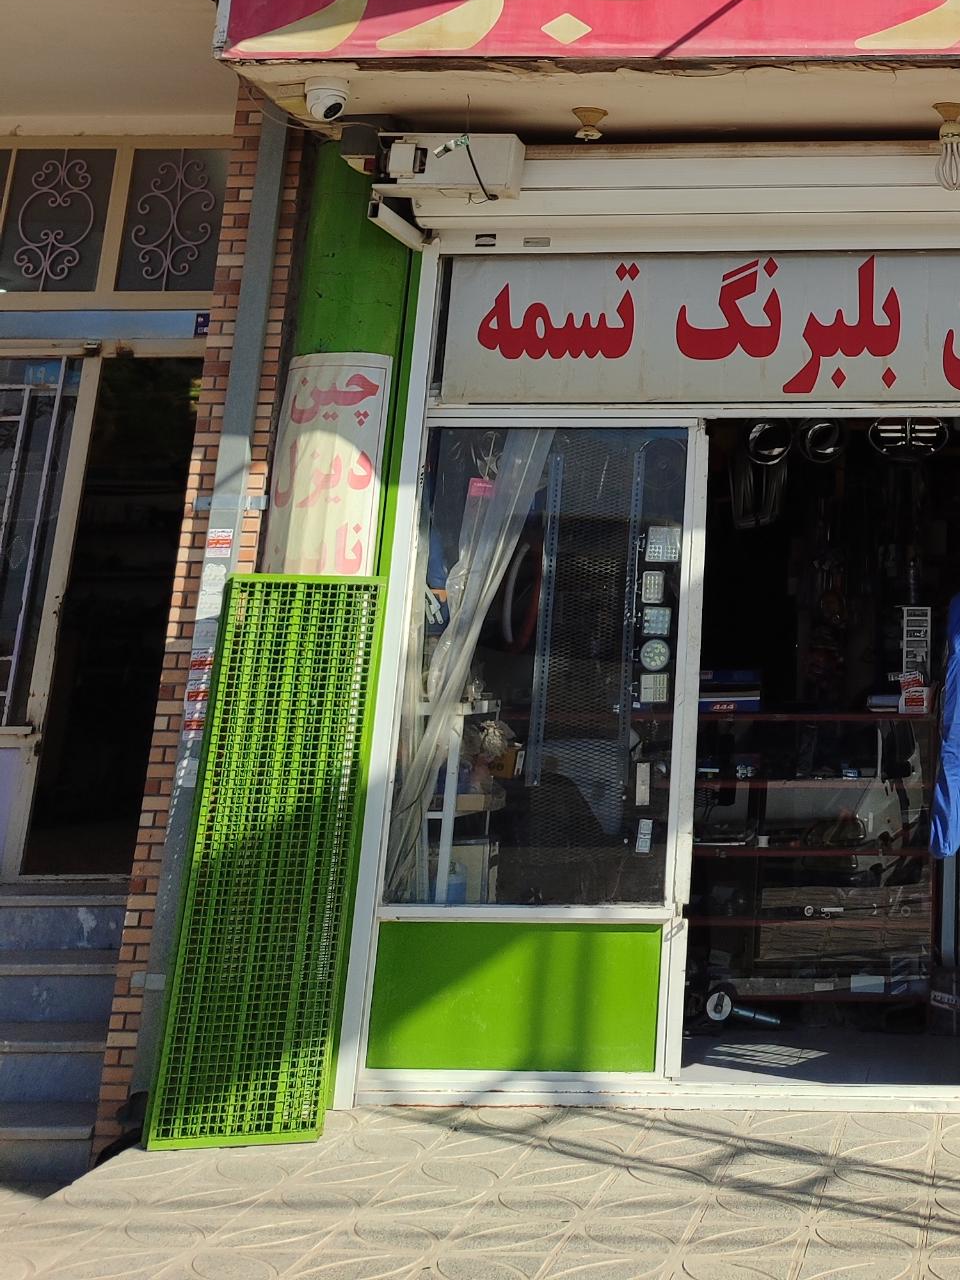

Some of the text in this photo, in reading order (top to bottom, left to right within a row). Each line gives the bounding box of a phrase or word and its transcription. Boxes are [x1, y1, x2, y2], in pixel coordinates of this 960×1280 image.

[477, 262, 640, 361] تسمه
[674, 255, 902, 395] بلبرنگ
[290, 372, 380, 427] چین
[273, 437, 374, 509] دیزل
